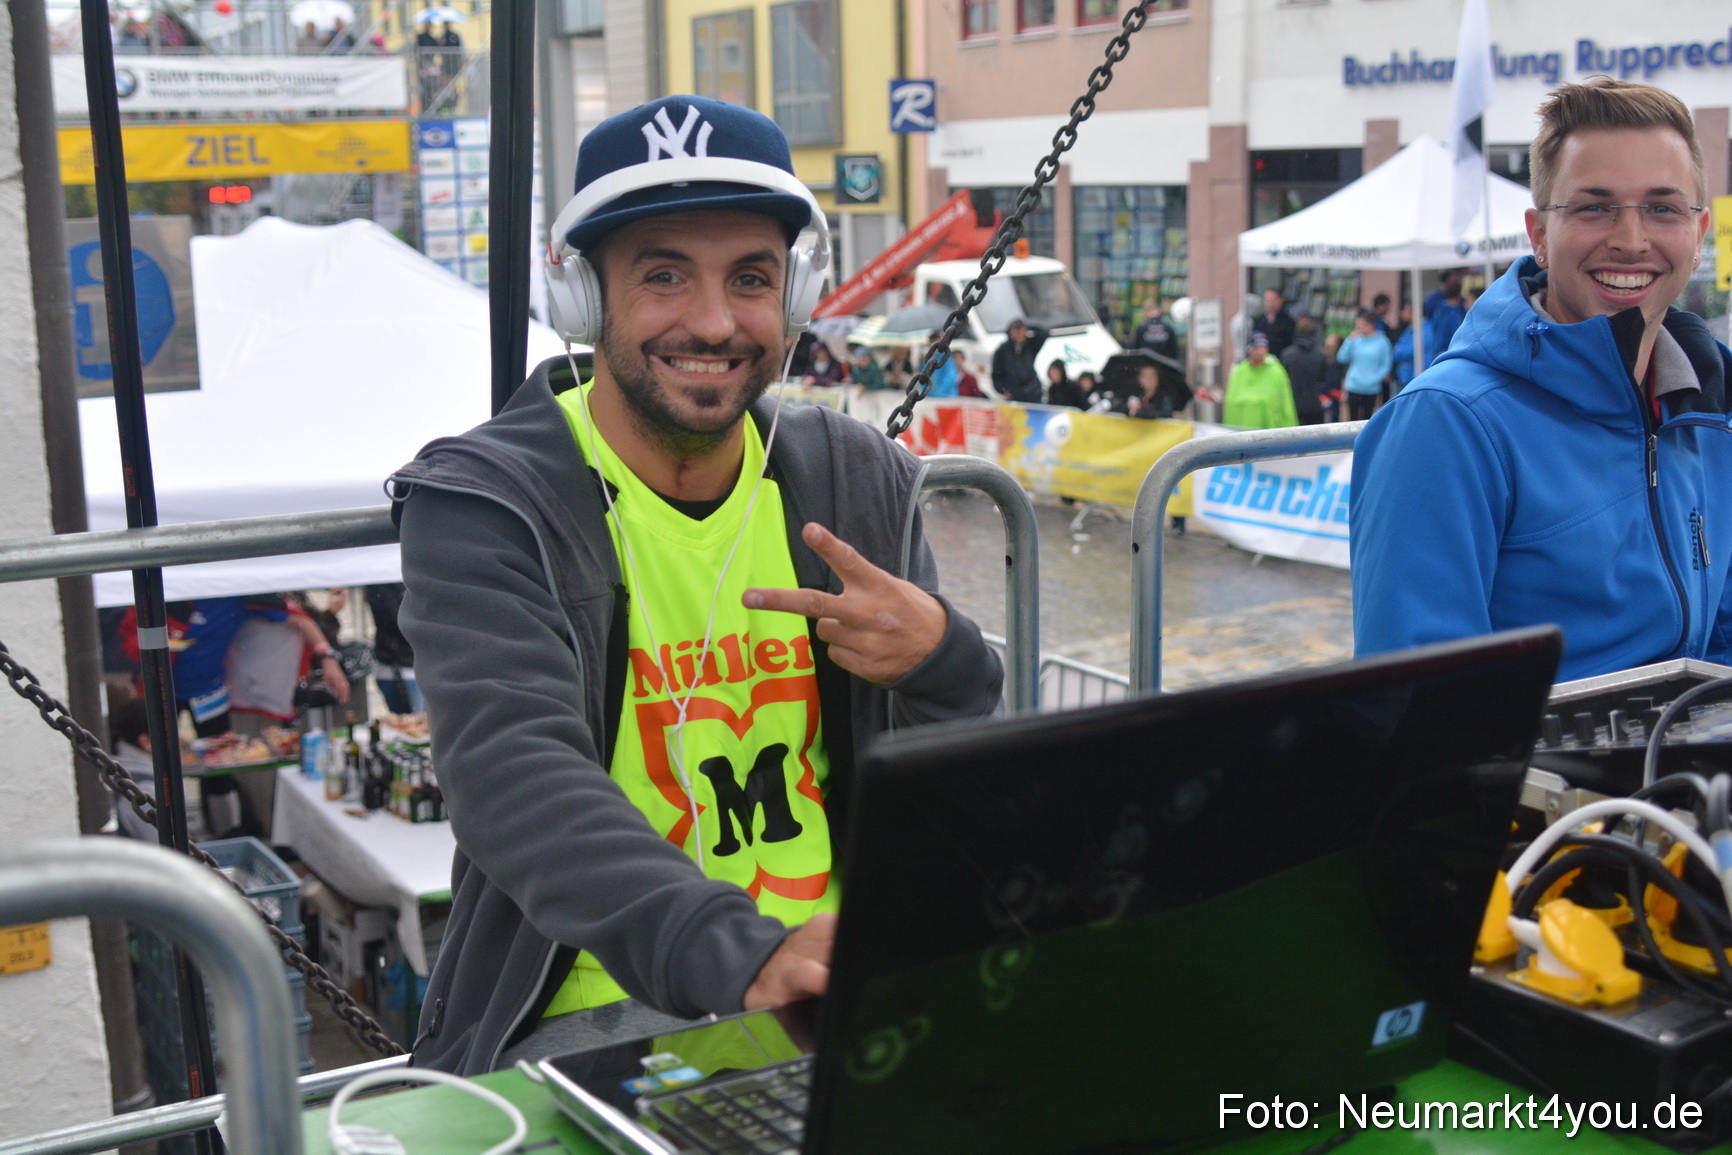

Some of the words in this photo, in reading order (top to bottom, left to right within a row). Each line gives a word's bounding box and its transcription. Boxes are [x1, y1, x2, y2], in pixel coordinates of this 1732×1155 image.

[185, 135, 270, 167] ZIEL
[628, 631, 814, 698] Müller
[698, 742, 803, 857] M
